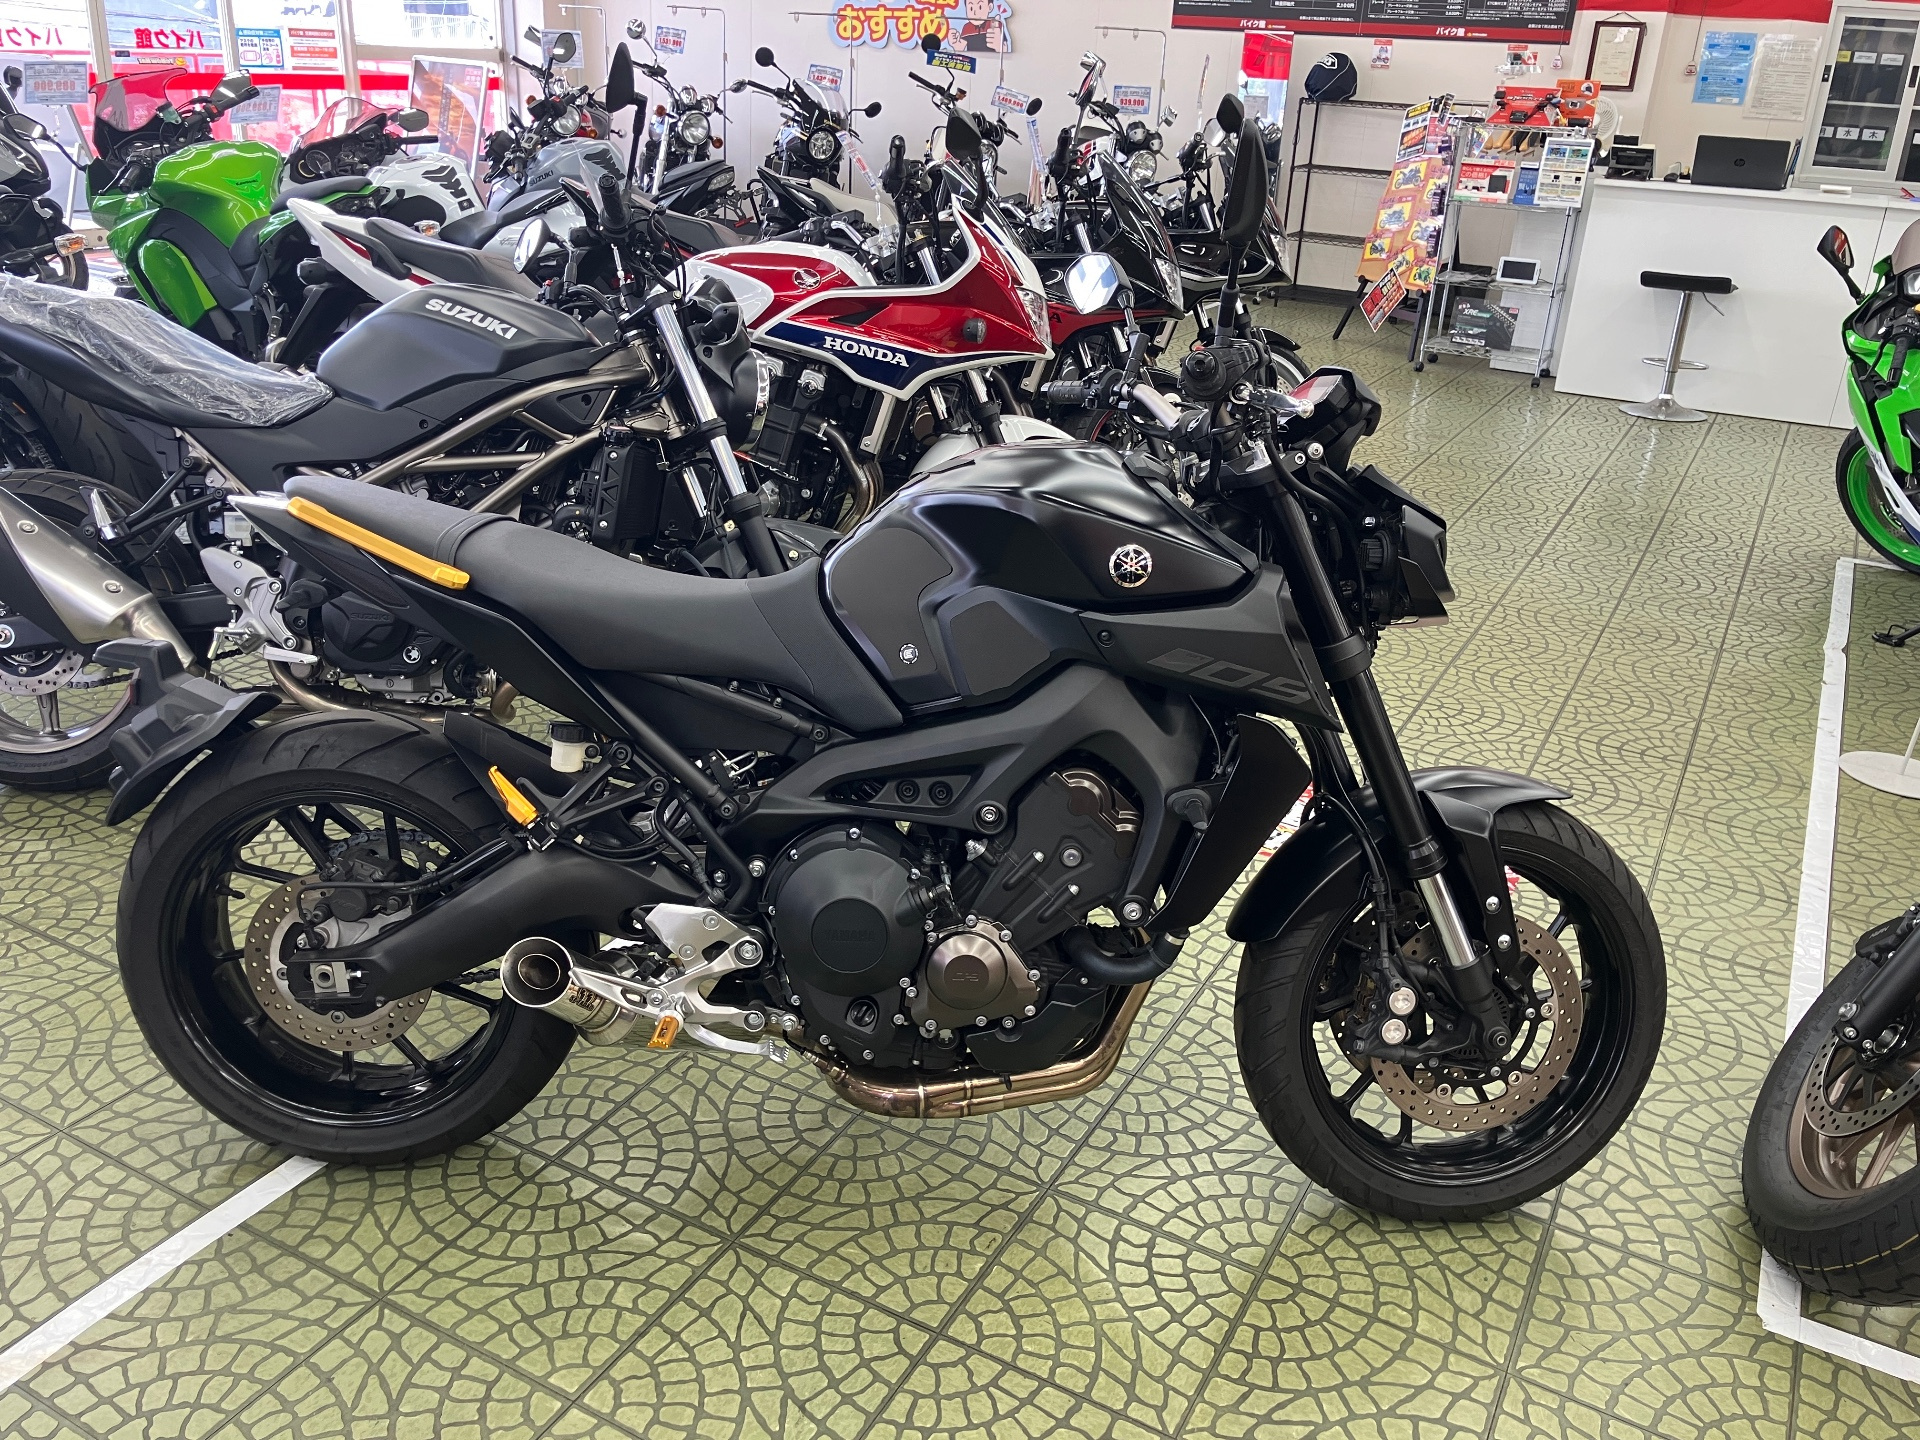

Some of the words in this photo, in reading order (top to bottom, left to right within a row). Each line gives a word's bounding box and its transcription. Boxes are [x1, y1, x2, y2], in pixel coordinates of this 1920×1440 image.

[836, 4, 949, 42] おすすめ
[1239, 19, 1267, 28] バイク館
[1435, 27, 1466, 37] バイク館
[1843, 128, 1853, 137] 水
[1868, 130, 1879, 139] 木
[530, 169, 554, 187] SUZUKI
[424, 298, 518, 340] SUZUKI
[823, 336, 910, 368] HONDA
[350, 612, 391, 621] SUZUKI
